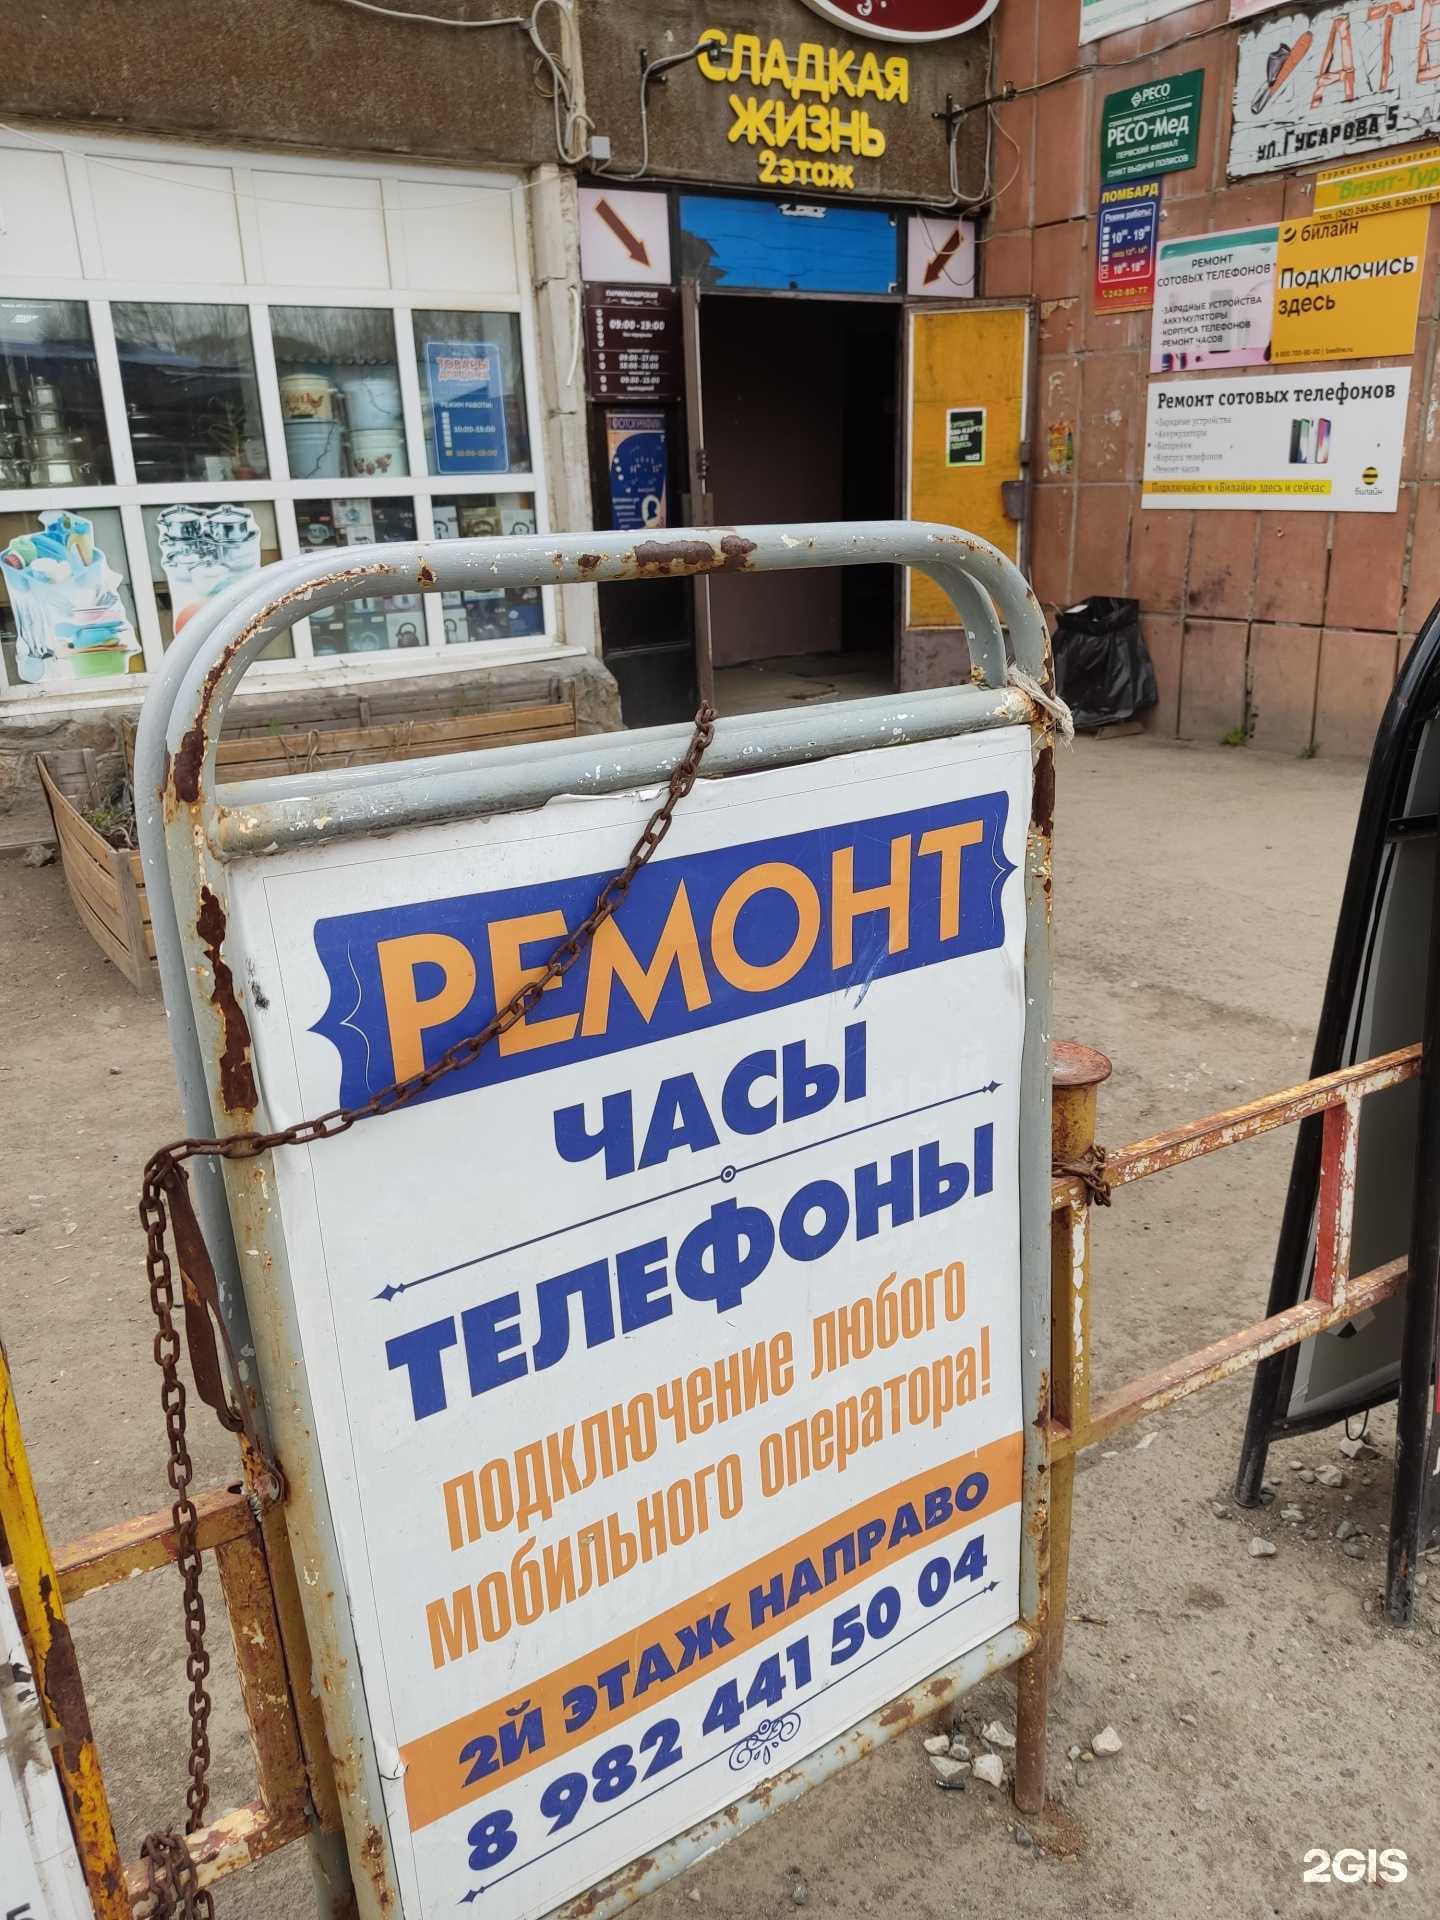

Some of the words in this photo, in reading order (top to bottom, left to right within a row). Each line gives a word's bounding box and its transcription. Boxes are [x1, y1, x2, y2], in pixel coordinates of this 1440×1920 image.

[697, 29, 909, 104] СЛАДКАЯ
[1140, 83, 1171, 101] РЕСО
[727, 94, 886, 158] ЖИЗНЬ
[1106, 115, 1190, 148] РЕСО-Мед
[1386, 105, 1400, 131] 5
[758, 150, 855, 189] 2этаж
[1101, 182, 1160, 204] ЛОМБАРД
[1301, 218, 1360, 242] билайн
[1157, 272, 1203, 287] СОТОВЫХ
[1206, 264, 1272, 281] ТЕЛЕФОНОВ
[1191, 254, 1234, 268] РЕМОНТ
[1280, 257, 1415, 290] Подключись
[1208, 295, 1263, 310] УСТРОЙСТВА
[1278, 295, 1336, 318] здесь
[1196, 334, 1224, 344] ЧАСОВ
[1201, 320, 1252, 333] ТЕЛЕФОНОВ
[1157, 393, 1214, 409] Ремонт
[1218, 390, 1289, 406] сотовых
[1293, 382, 1396, 405] телефонов
[377, 819, 984, 1086] РЕМОНТ
[553, 1020, 867, 1180] ЧАСЫ
[384, 1121, 994, 1422] ТЕЛЕФОНЫ
[810, 1260, 966, 1380] любого
[760, 1325, 992, 1499] оператора!
[459, 1698, 546, 1789] 2Й
[562, 1602, 735, 1735] ЭТАЖ
[748, 1470, 990, 1630] НАПРАВО
[467, 1809, 518, 1871] 8
[540, 1717, 683, 1837] 982
[701, 1635, 812, 1737] 441
[830, 1585, 901, 1667] 50
[917, 1534, 989, 1609] 04
